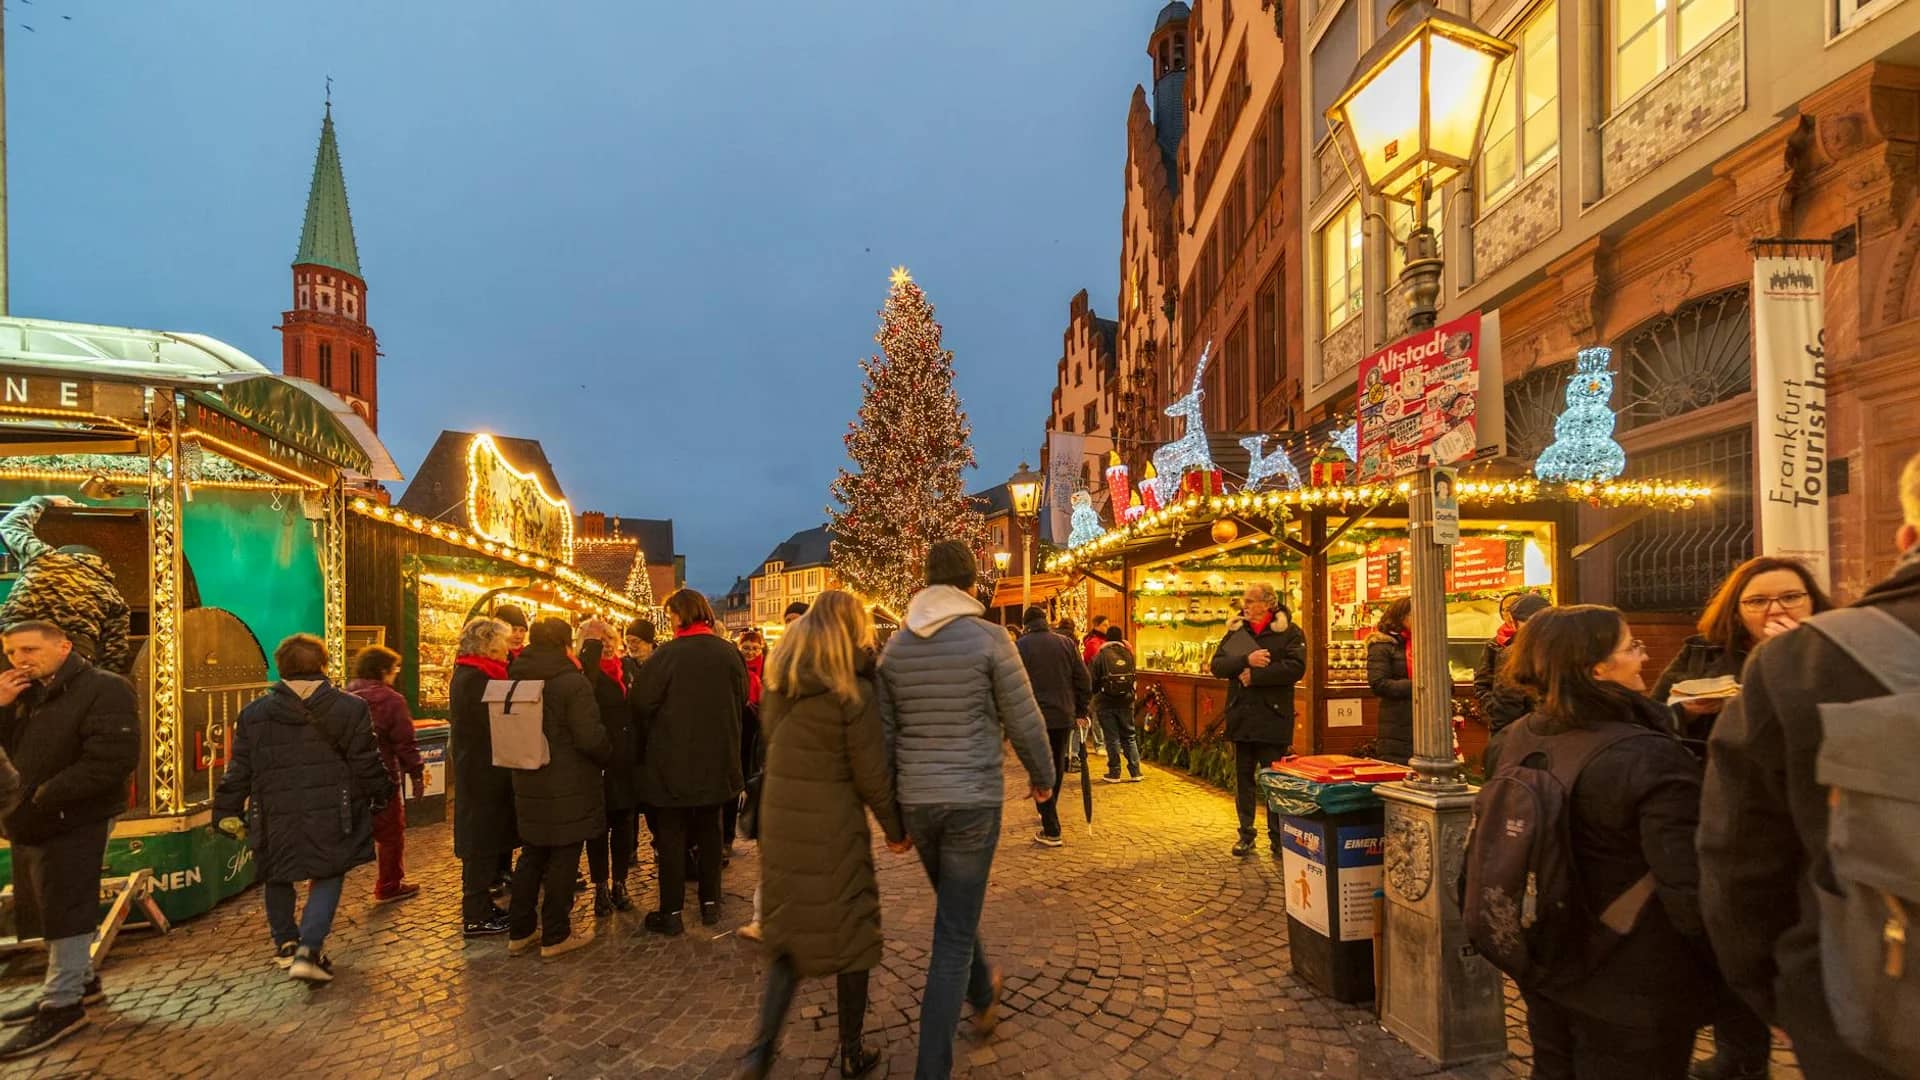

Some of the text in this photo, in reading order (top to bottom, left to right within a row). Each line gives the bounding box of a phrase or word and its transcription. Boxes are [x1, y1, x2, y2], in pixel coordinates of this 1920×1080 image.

[1378, 330, 1448, 374] Altstadt
[1768, 379, 1801, 504] Frankfurt
[1794, 401, 1826, 508] Tourist
[1344, 838, 1378, 850] EIMER
